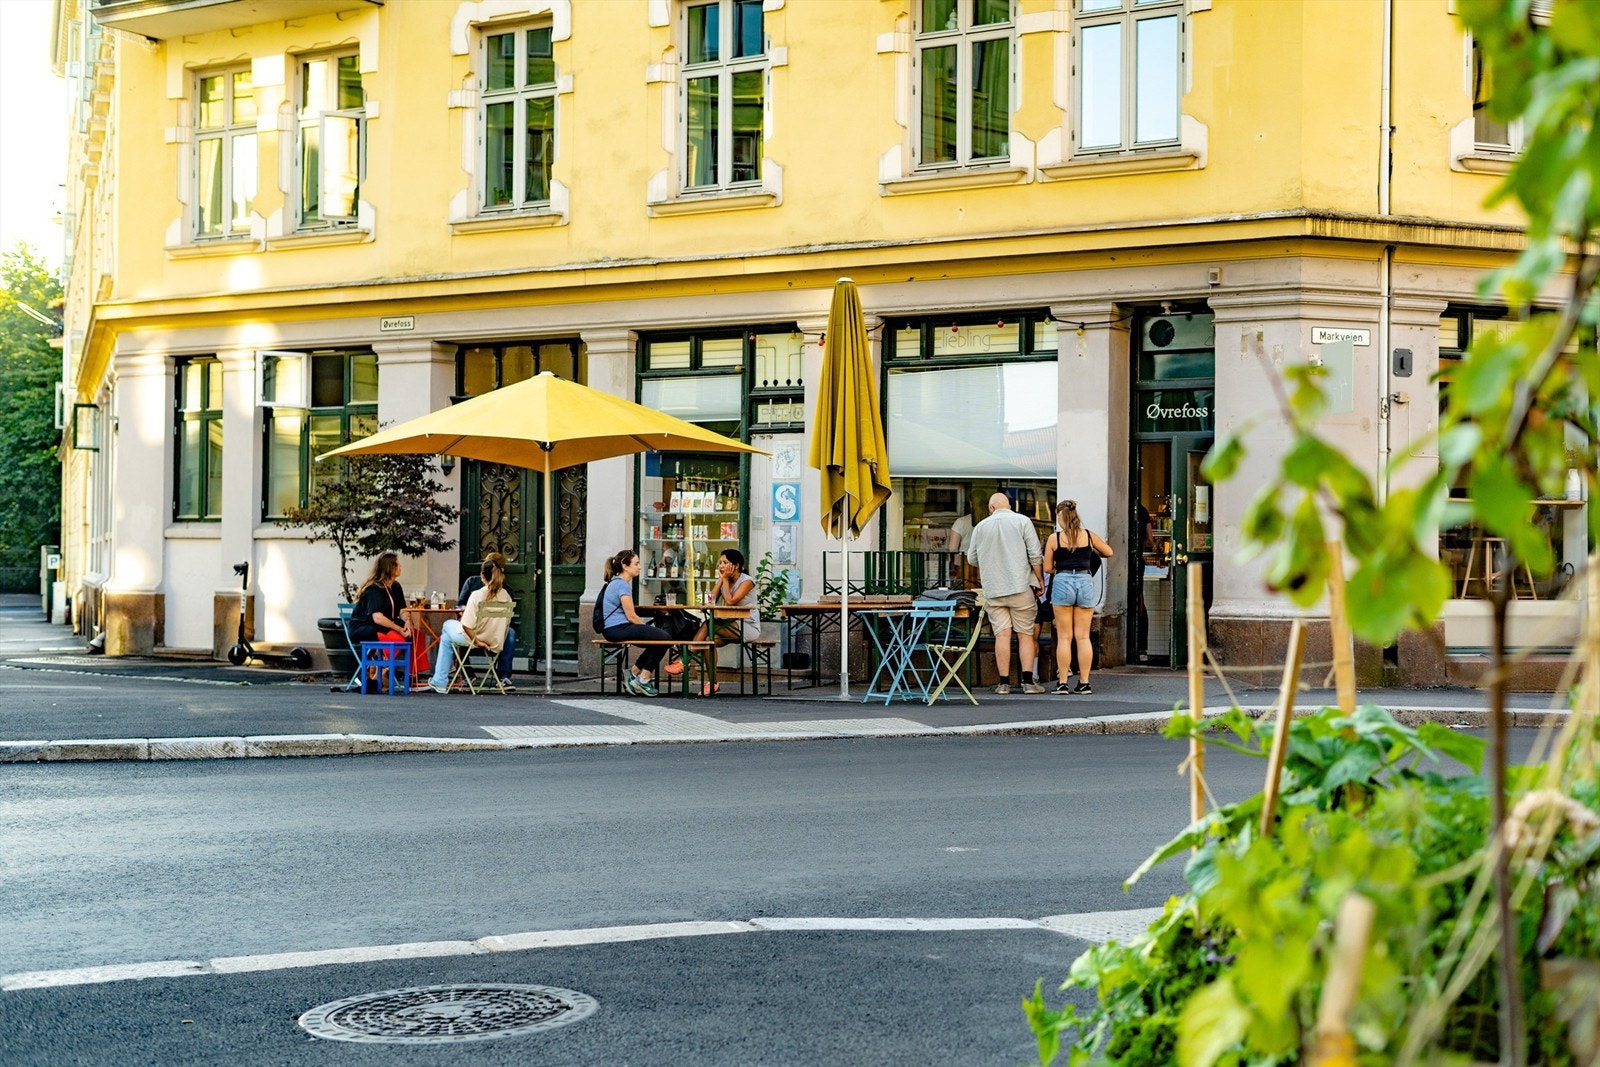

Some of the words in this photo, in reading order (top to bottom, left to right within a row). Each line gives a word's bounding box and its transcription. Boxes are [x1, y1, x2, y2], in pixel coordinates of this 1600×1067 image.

[383, 320, 411, 328] Øvrefoss
[942, 328, 991, 352] liebling
[1319, 331, 1363, 342] Markveien
[1146, 402, 1209, 419] Øvrefoss
